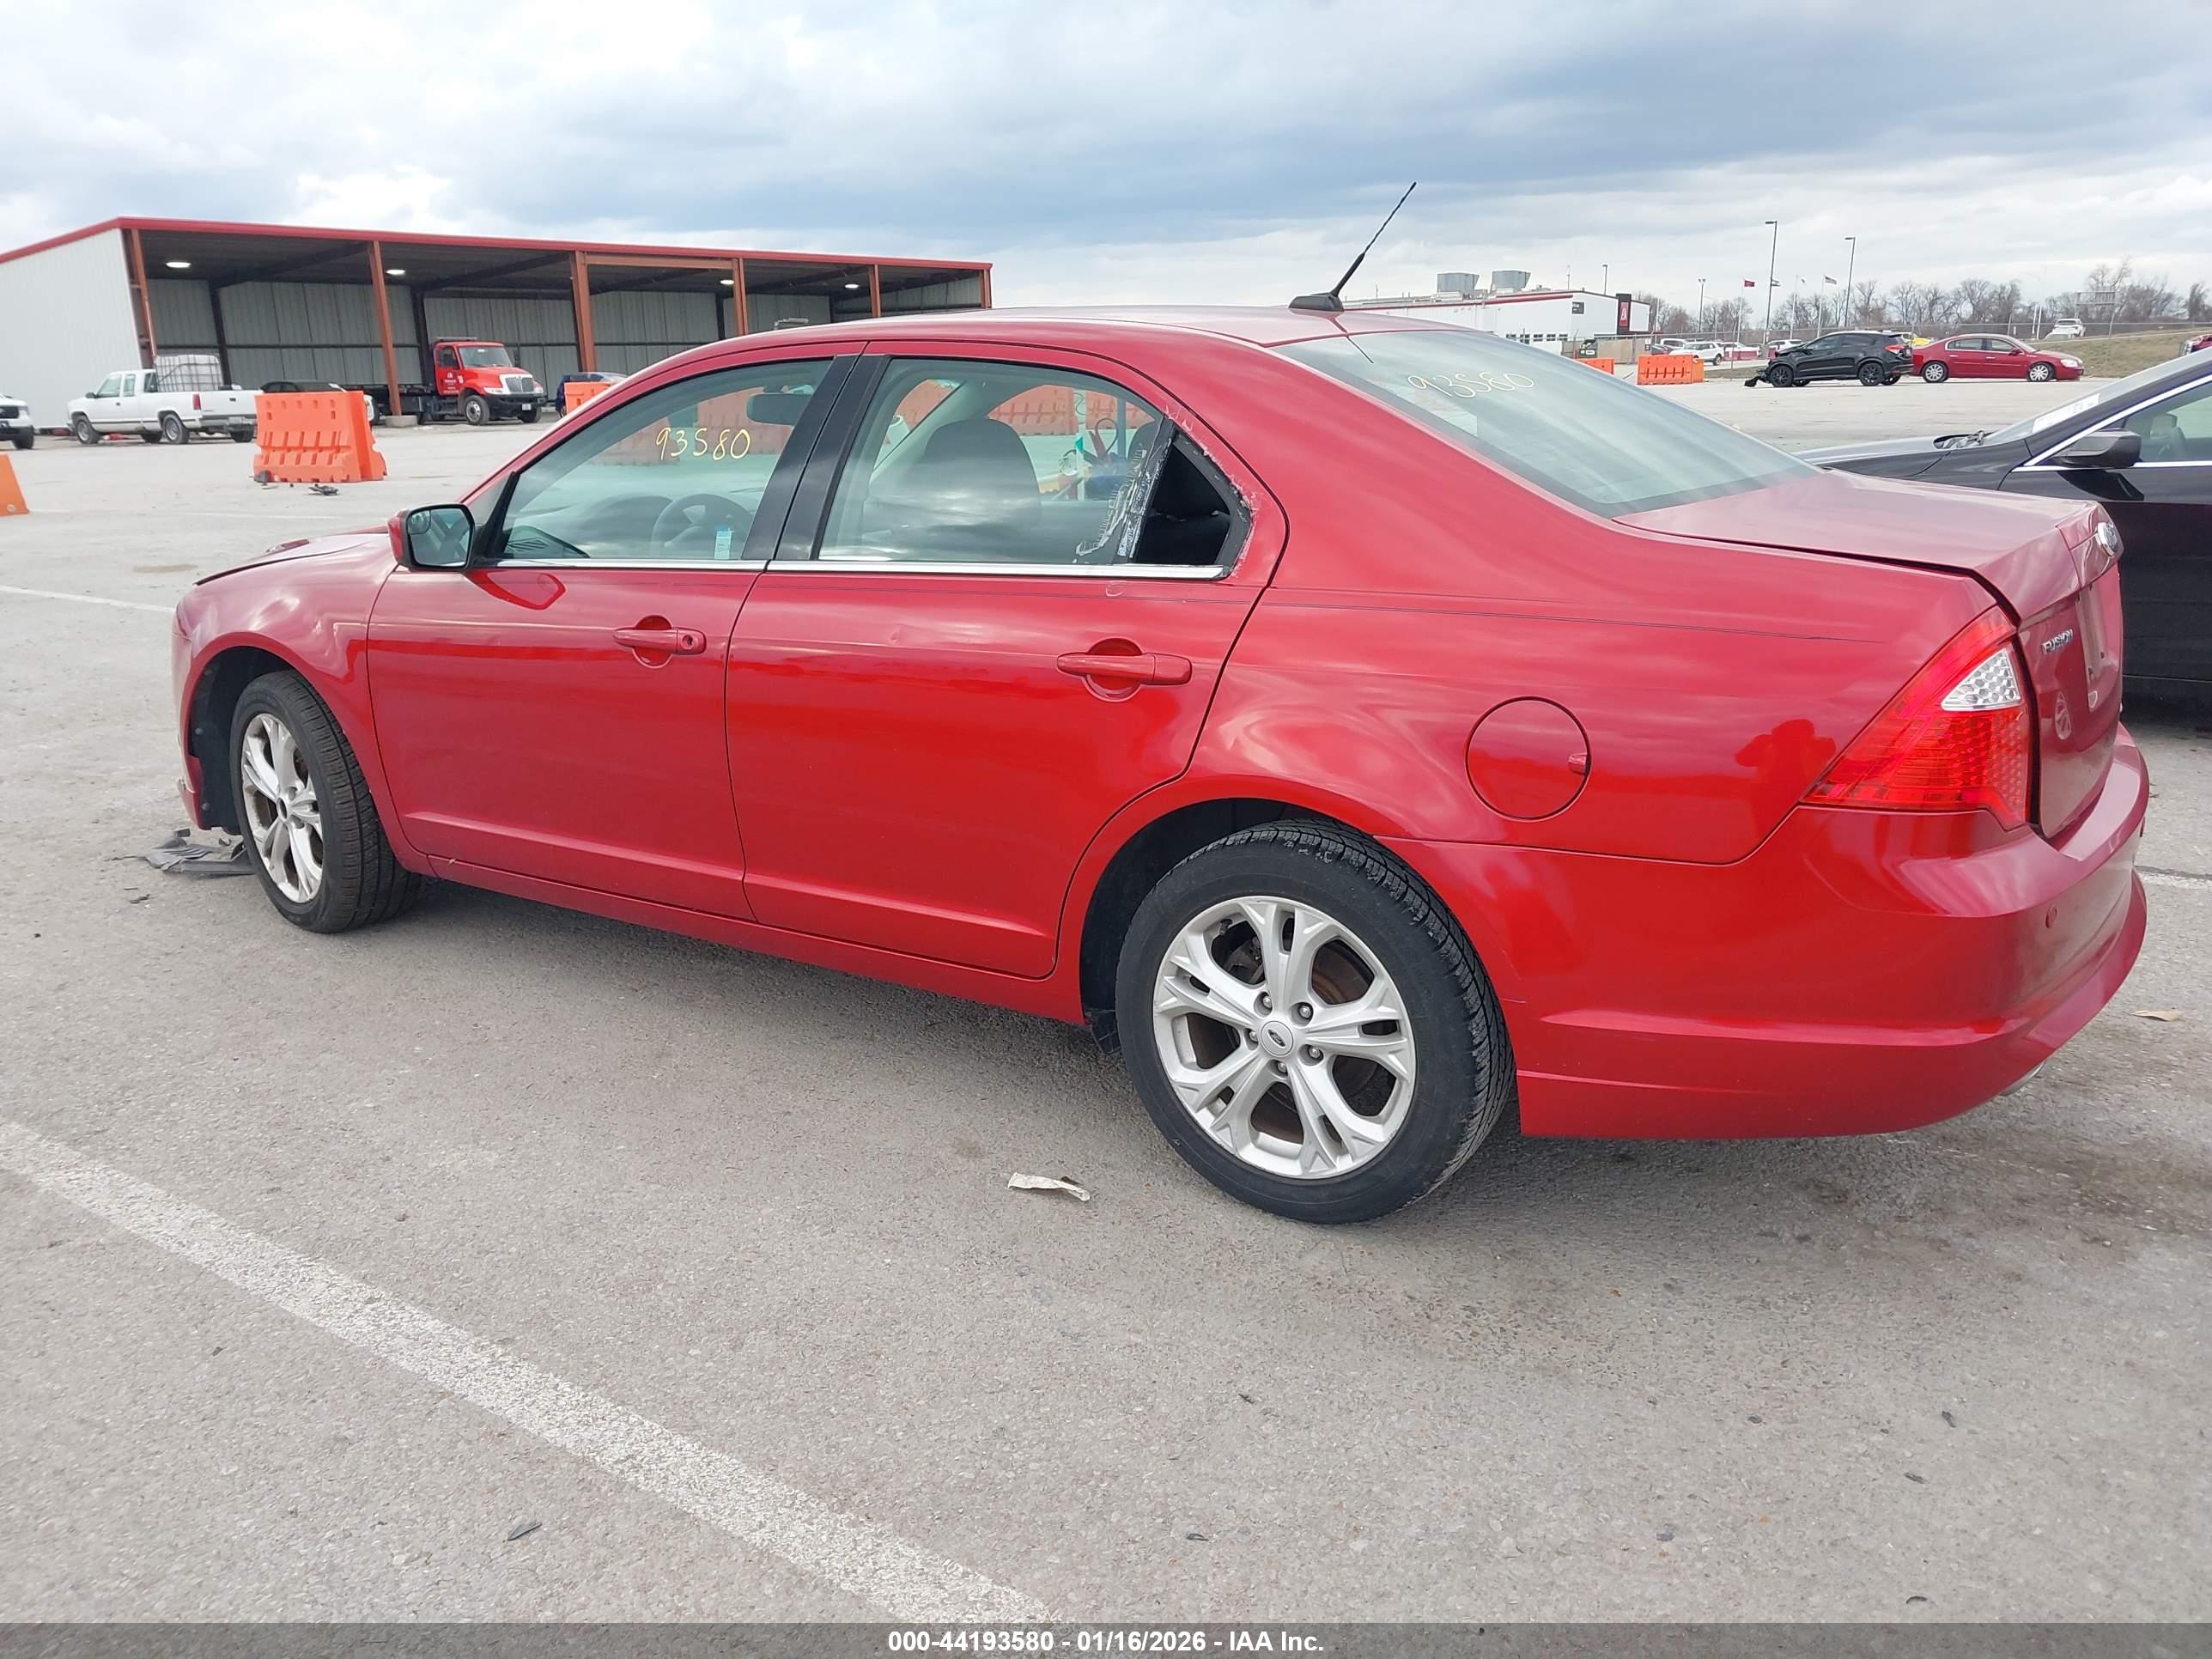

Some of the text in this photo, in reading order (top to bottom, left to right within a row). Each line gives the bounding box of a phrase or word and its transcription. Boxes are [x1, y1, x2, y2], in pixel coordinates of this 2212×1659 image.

[1407, 371, 1534, 398] 93580
[655, 427, 751, 461] 93580
[2041, 628, 2074, 656] FUSION
